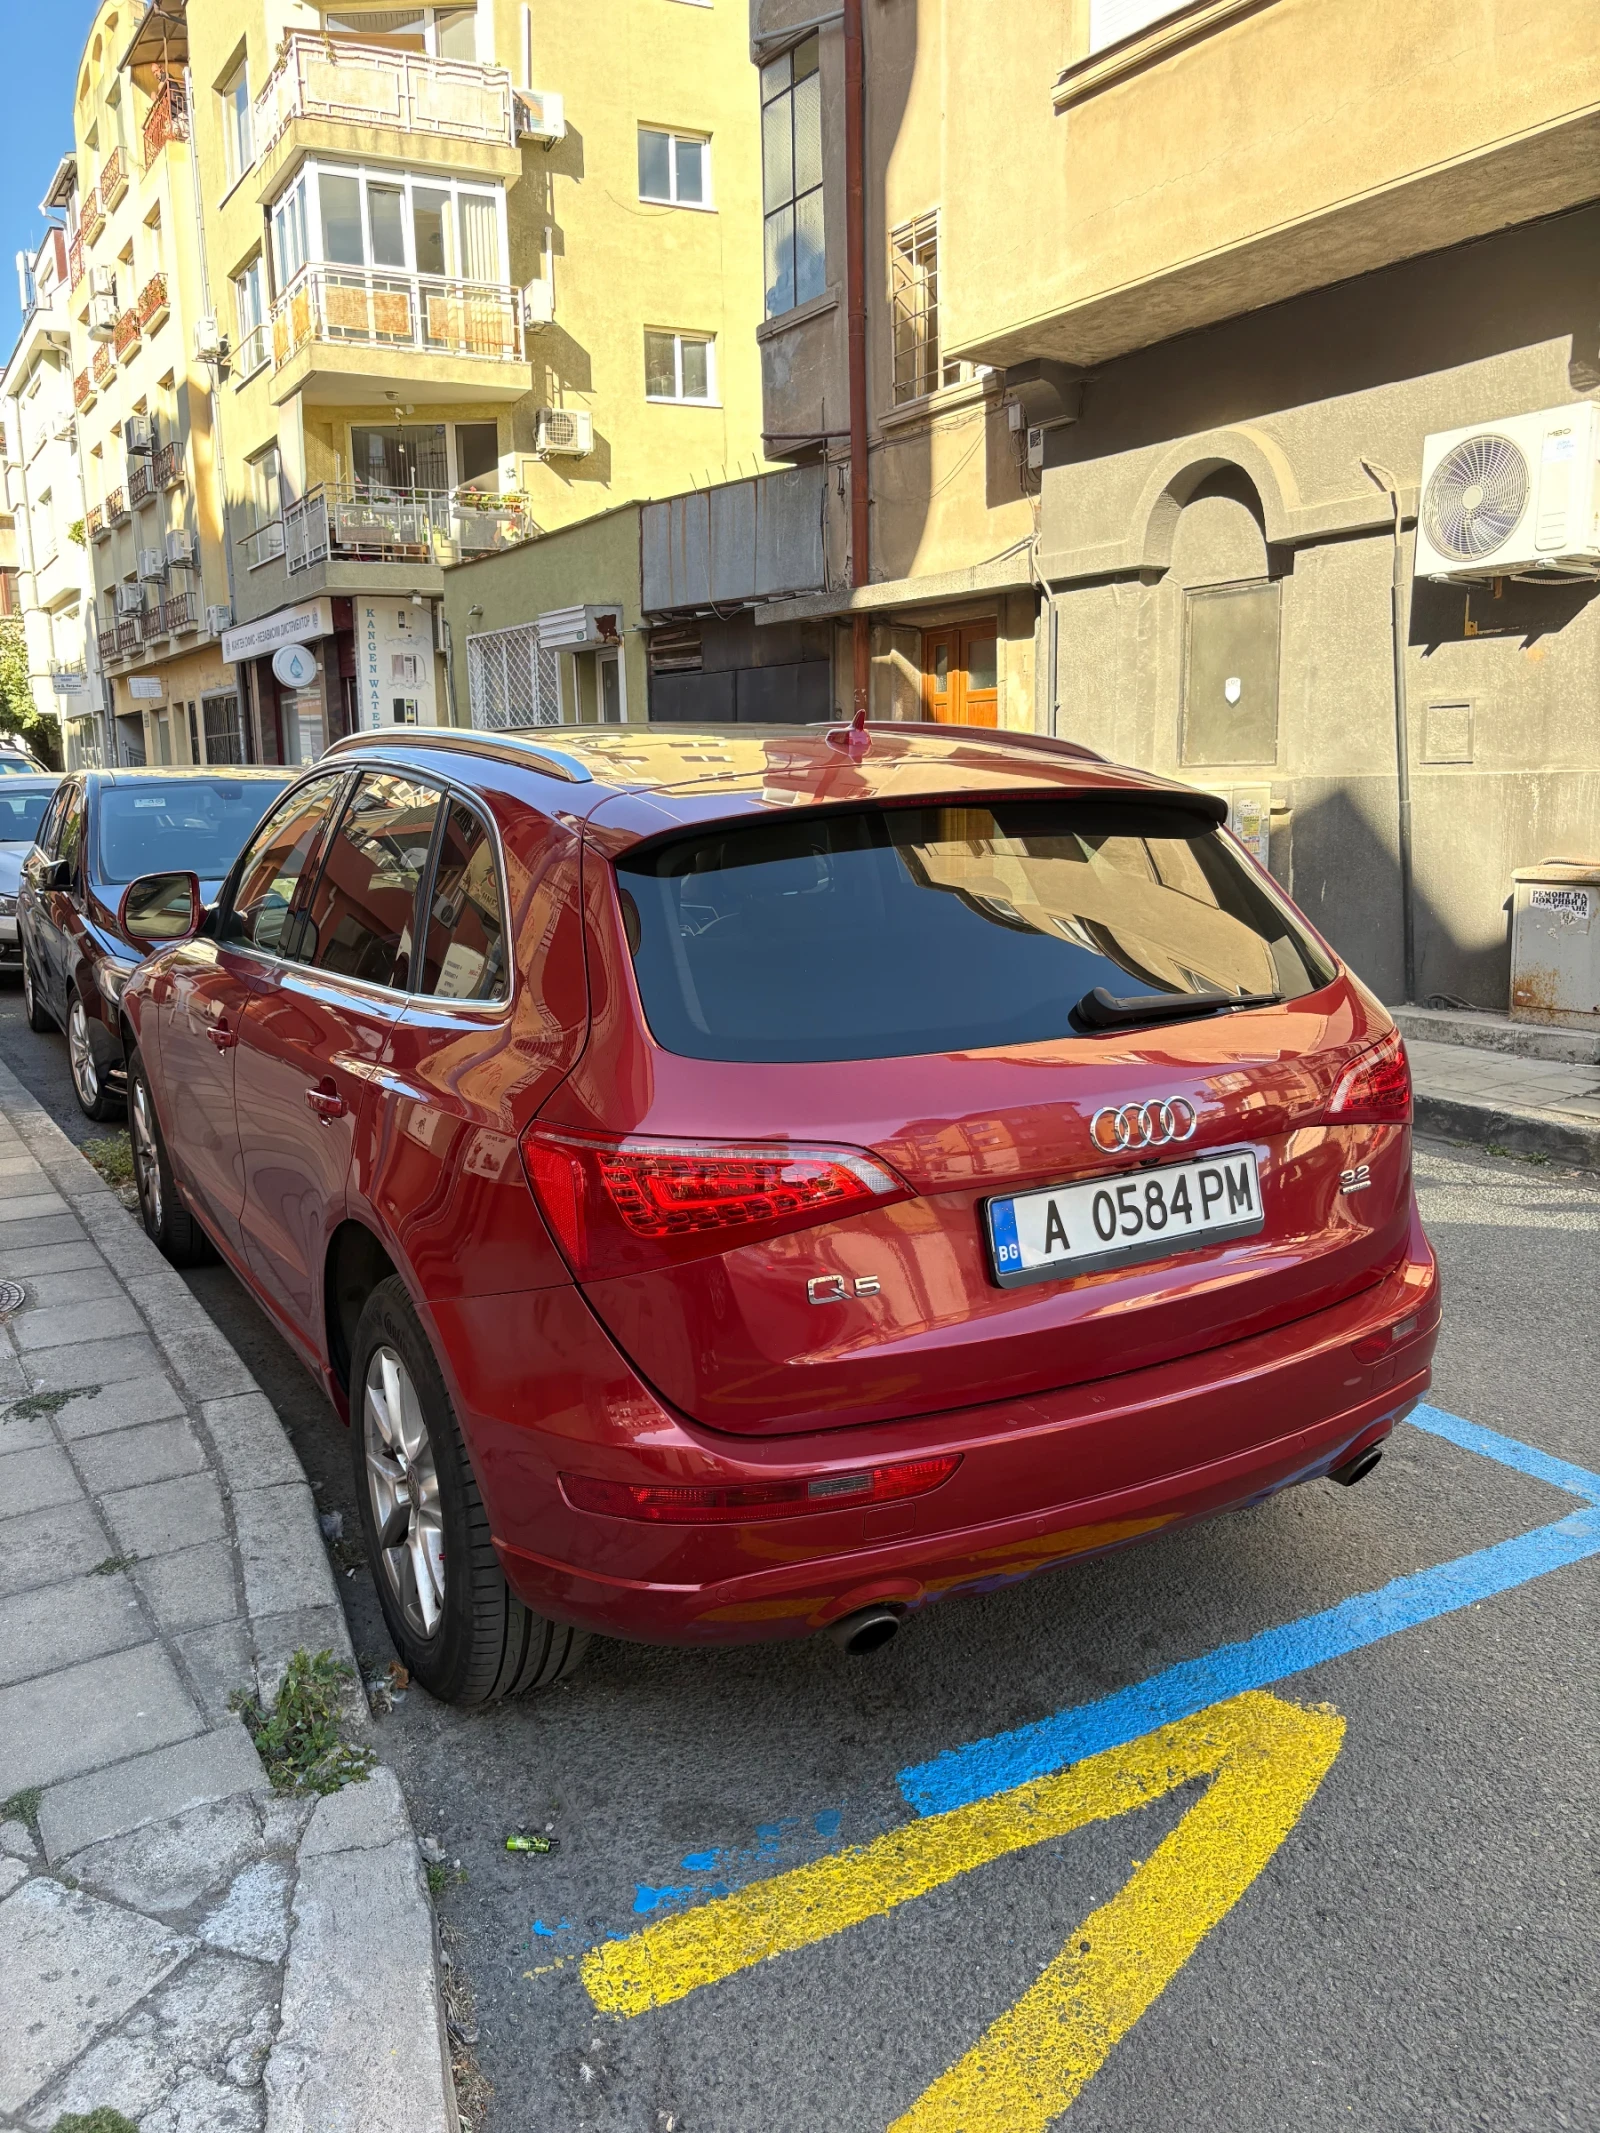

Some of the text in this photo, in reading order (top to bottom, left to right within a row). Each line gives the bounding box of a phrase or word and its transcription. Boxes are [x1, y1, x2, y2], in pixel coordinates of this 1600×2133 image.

[366, 608, 377, 674] KANGEN
[1532, 890, 1588, 900] РЕМОНТ НА
[1532, 897, 1578, 906] ПОКРИВИ
[1045, 1162, 1254, 1254] A 0584 PM
[998, 1243, 1019, 1262] BG
